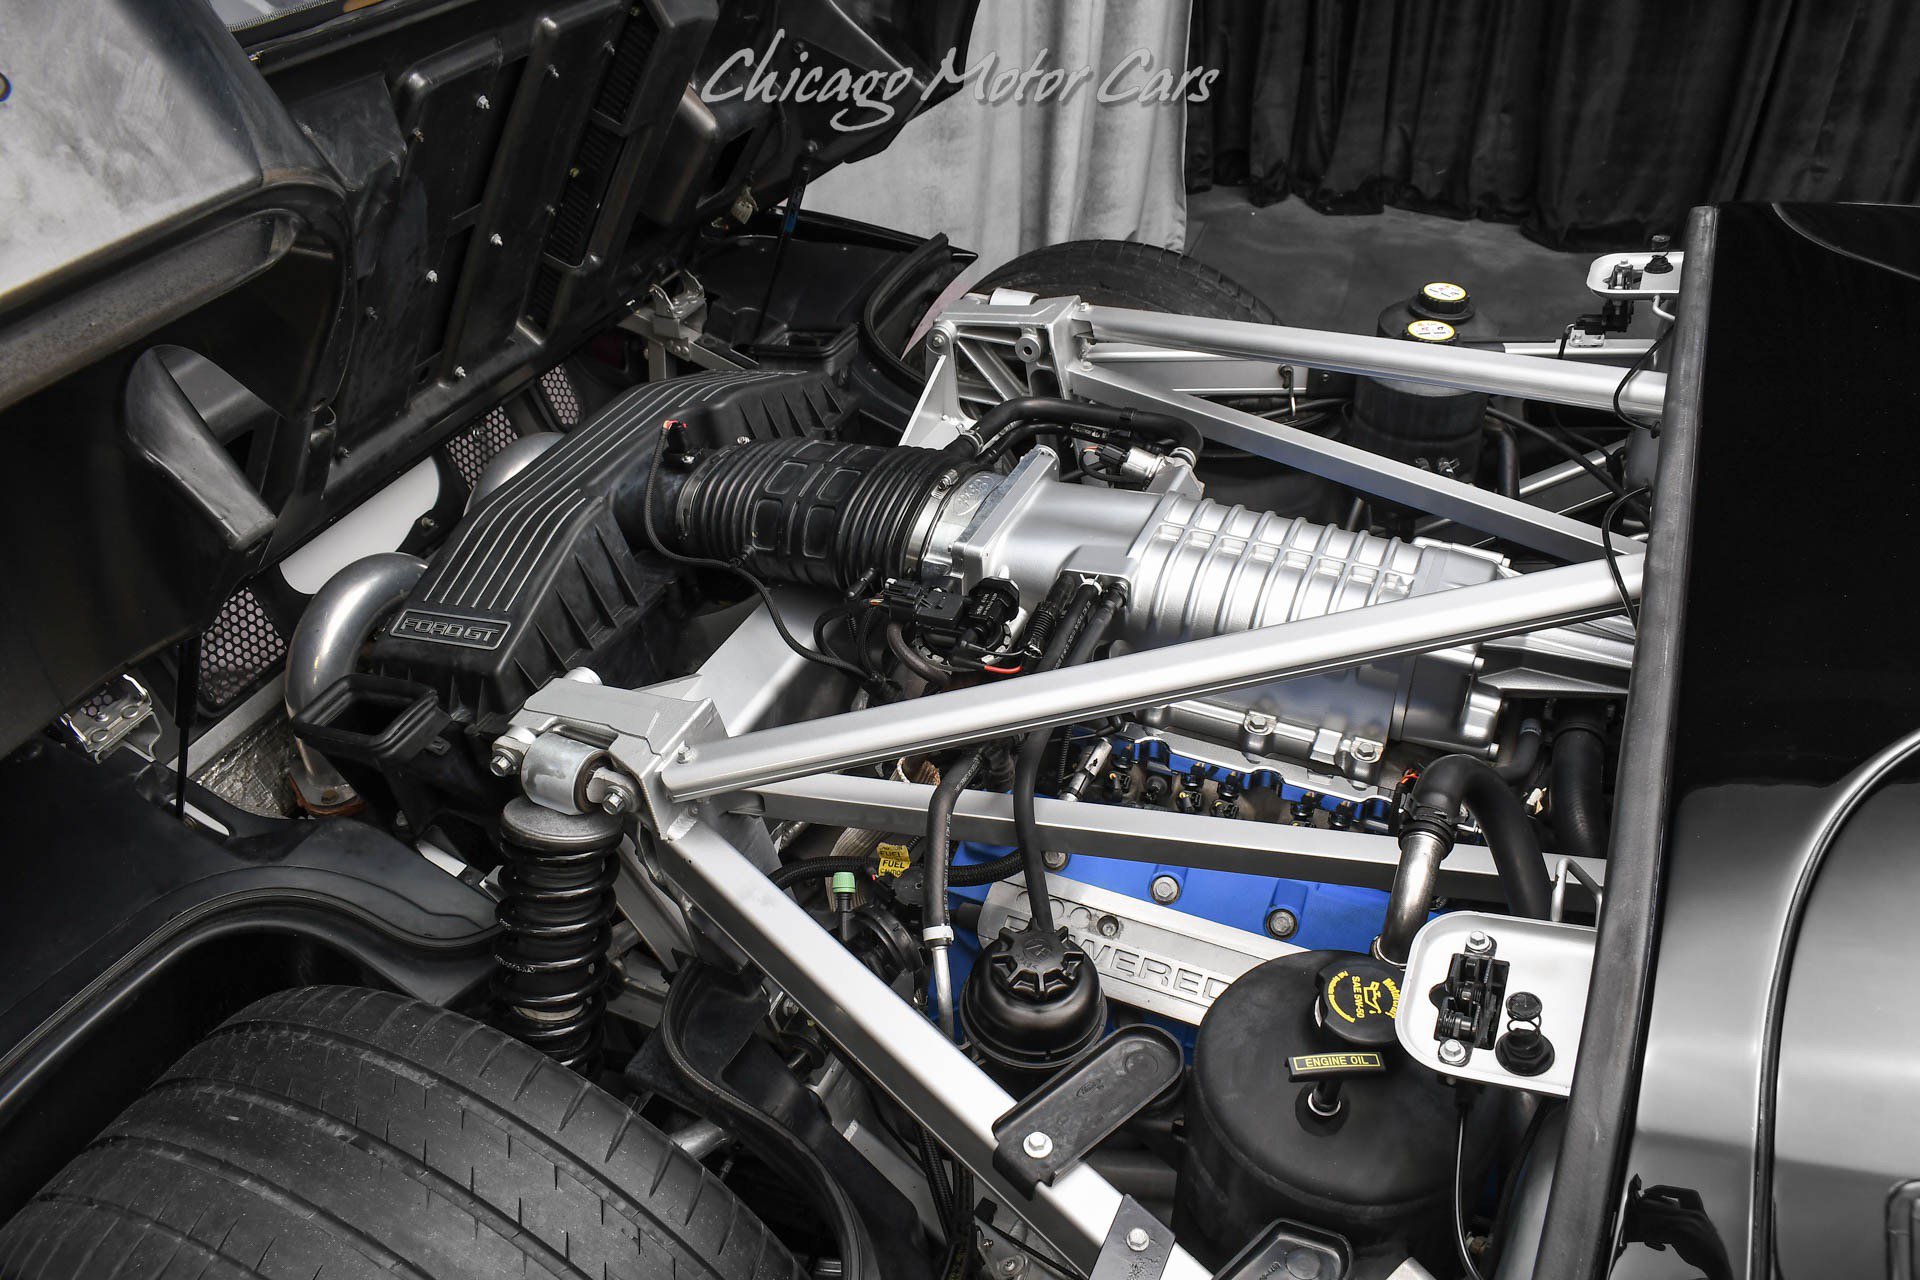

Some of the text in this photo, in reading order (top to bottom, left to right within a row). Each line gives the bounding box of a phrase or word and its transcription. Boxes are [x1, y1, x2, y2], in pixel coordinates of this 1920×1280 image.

[401, 618, 500, 642] FORD GT
[882, 860, 905, 868] FUEL
[1352, 976, 1365, 1018] SAE 5W-50
[1305, 1055, 1369, 1067] ENGINE OIL
